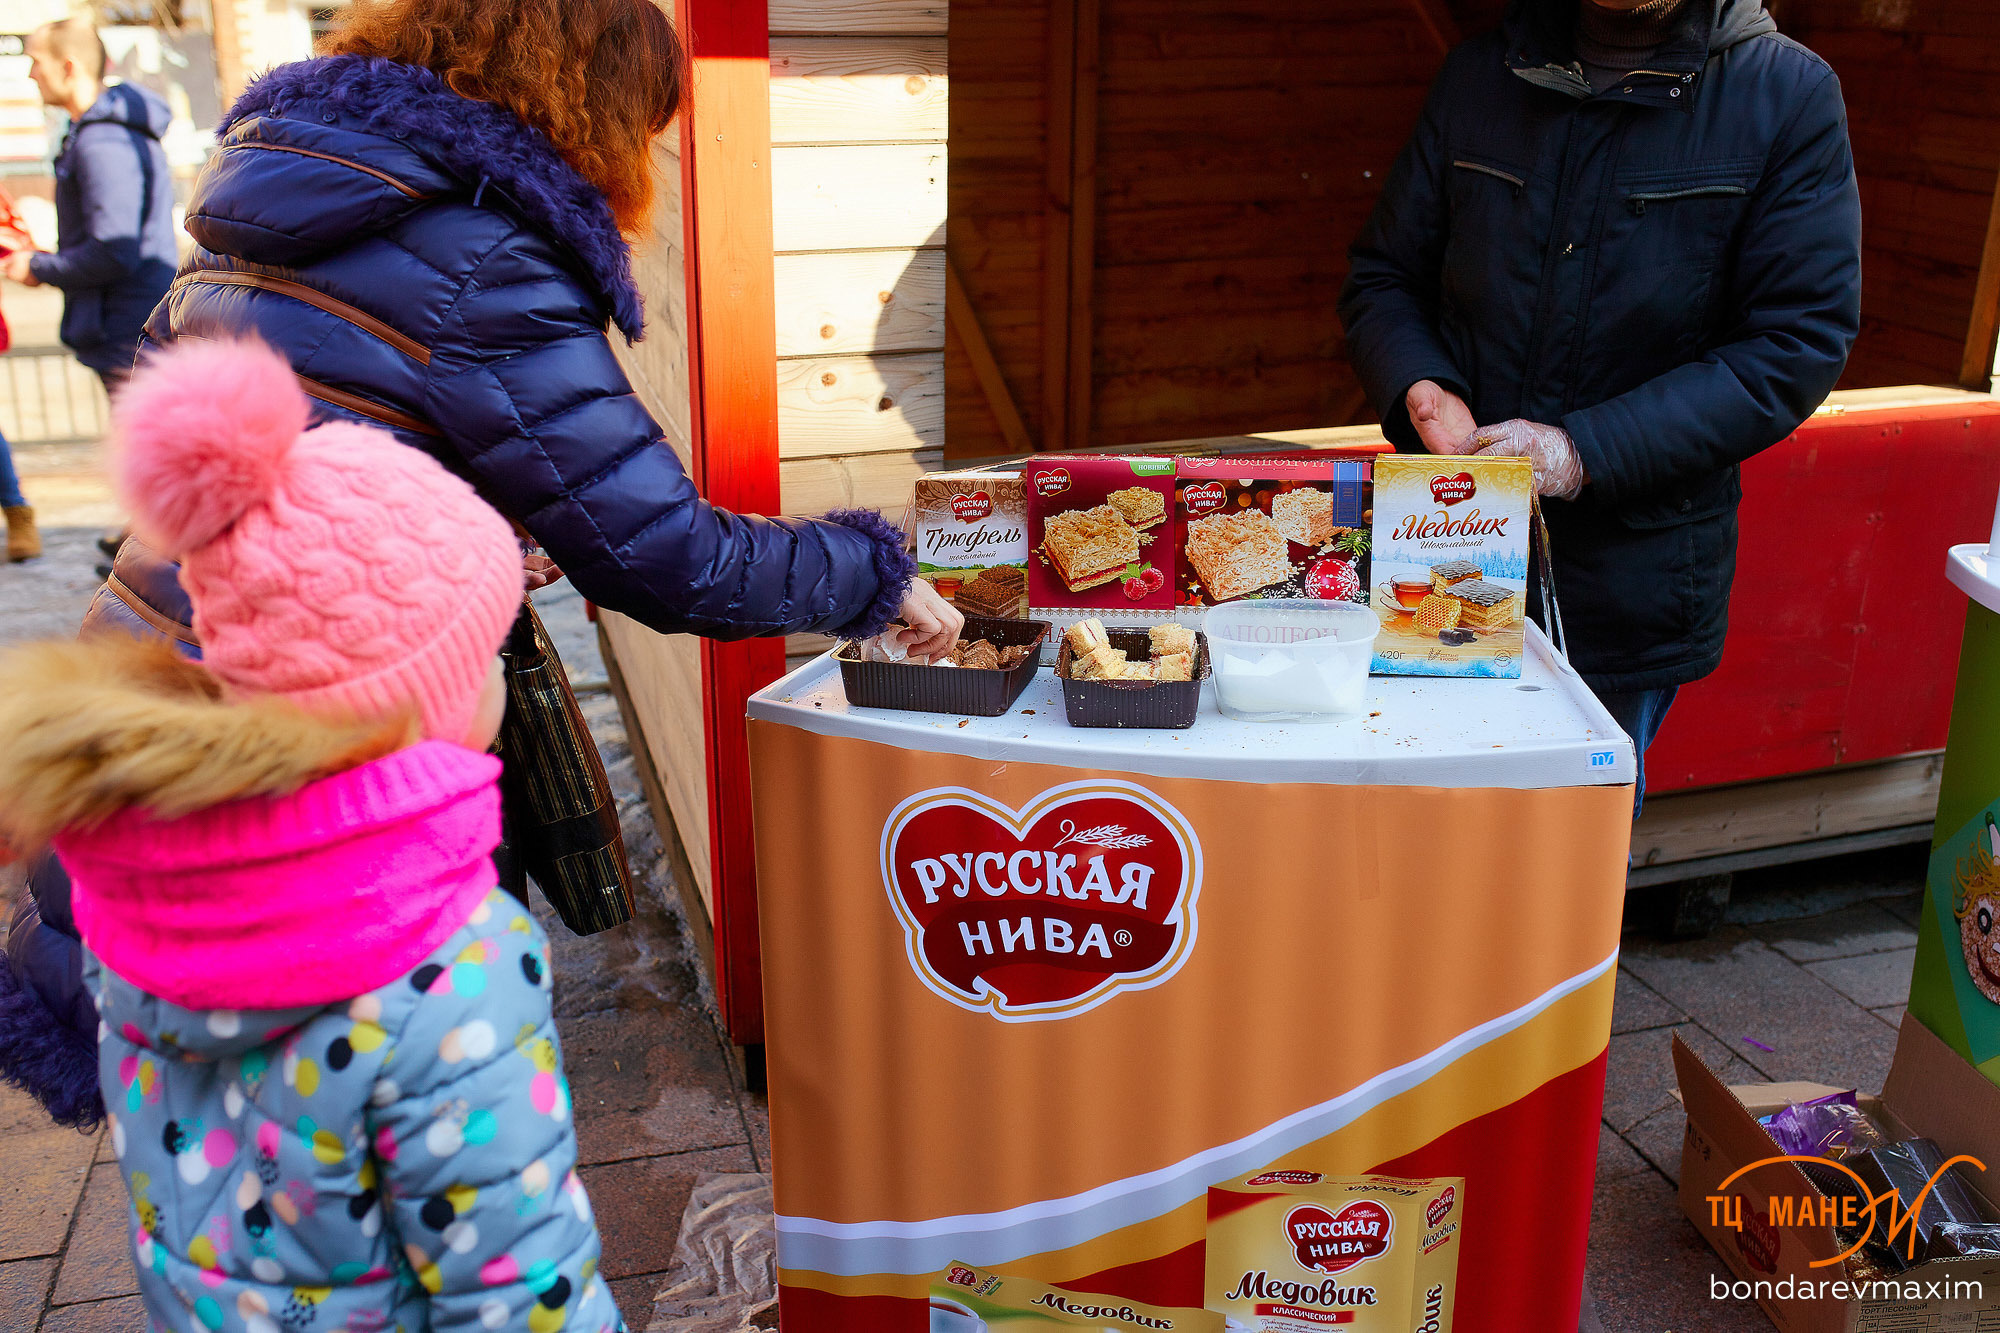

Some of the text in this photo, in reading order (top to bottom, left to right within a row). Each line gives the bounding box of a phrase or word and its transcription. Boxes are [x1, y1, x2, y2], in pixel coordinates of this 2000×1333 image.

[1037, 475, 1068, 484] РУССКАЯ
[1432, 480, 1473, 492] РУССКАЯ
[1186, 490, 1223, 501] РУССКАЯ
[1441, 491, 1465, 501] НИВА
[953, 500, 989, 510] РУССКАЯ
[1195, 500, 1217, 508] НИВА
[961, 509, 983, 517] НИВА
[1392, 508, 1509, 542] Медовик
[925, 524, 1022, 556] Трюфель
[911, 850, 1156, 910] РУССКАЯ
[1294, 1220, 1381, 1240] РУССКАЯ
[1225, 1270, 1378, 1307] Медовик
[1030, 1293, 1175, 1331] Медовик
[1272, 1306, 1337, 1321] КЛАССИЧЕСКИЙ
[1882, 1303, 1928, 1313] ПЕСОЧНЫЙ
